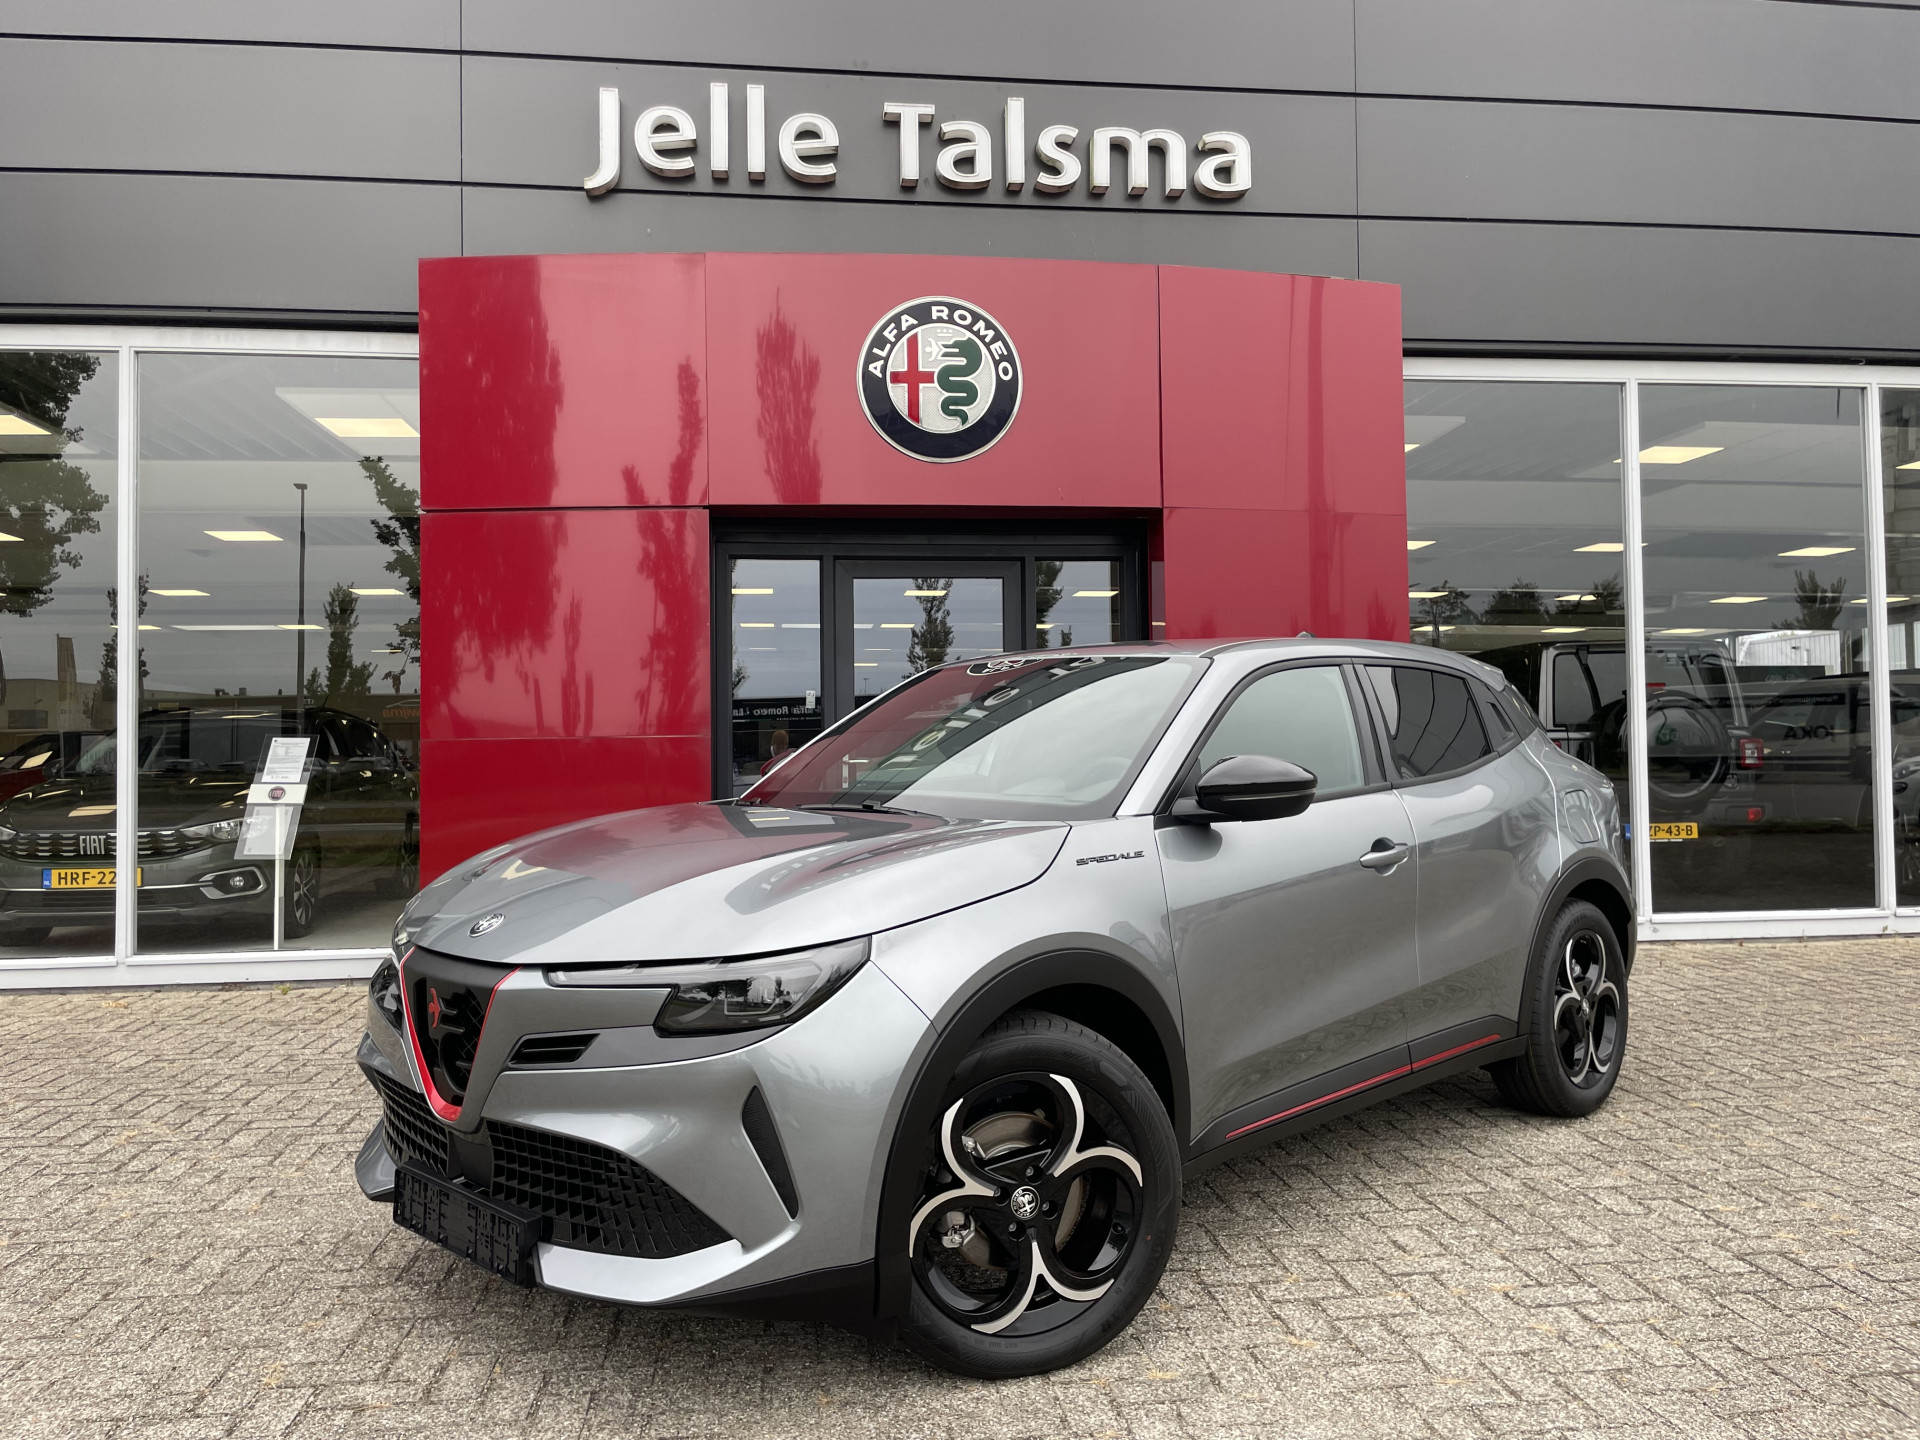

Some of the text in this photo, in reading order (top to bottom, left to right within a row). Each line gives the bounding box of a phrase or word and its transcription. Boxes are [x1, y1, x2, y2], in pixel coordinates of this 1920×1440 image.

[584, 82, 1252, 199] Jelle Talsma
[868, 306, 1013, 381] ALFA ROMEO
[79, 835, 107, 855] FIAT
[1076, 850, 1145, 866] SPECIALE
